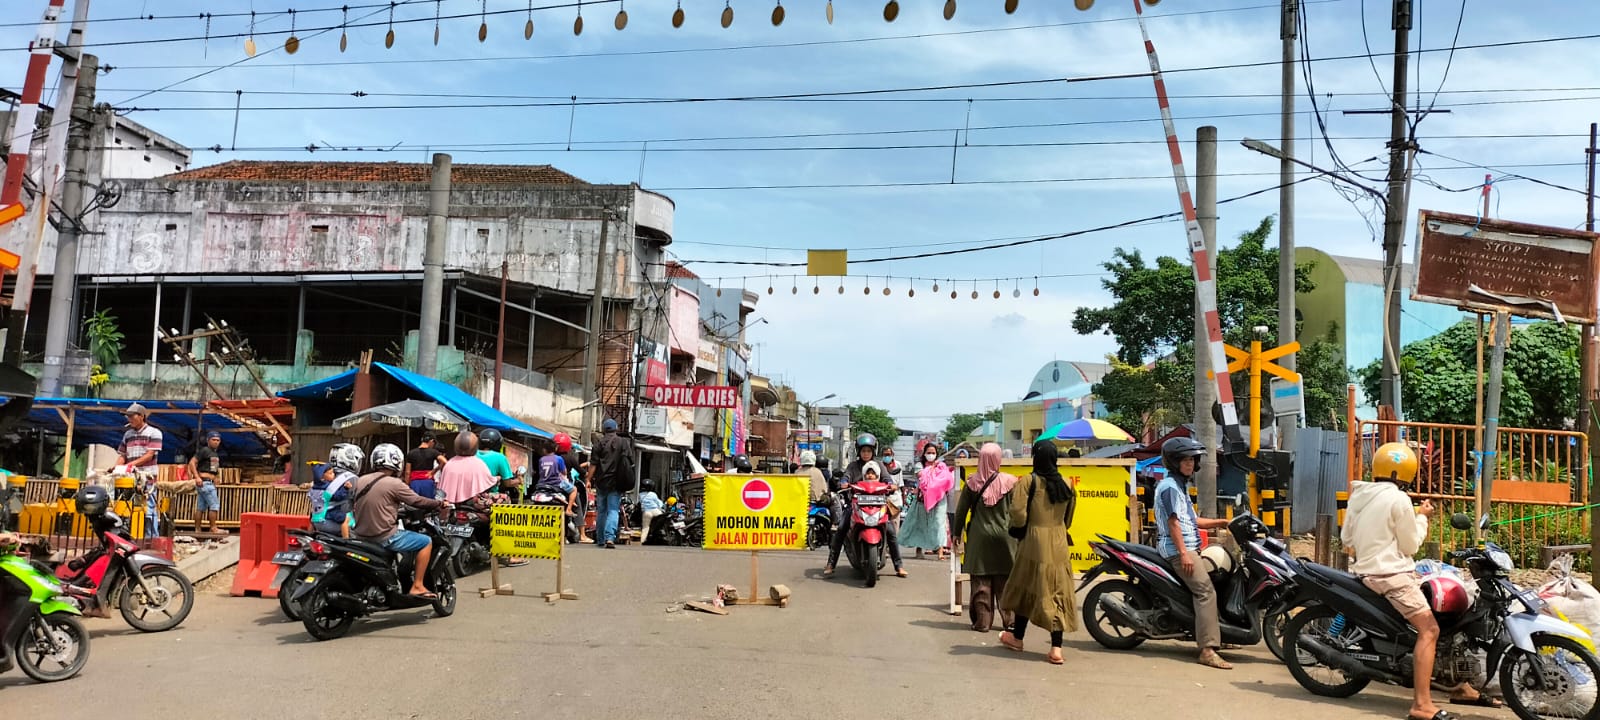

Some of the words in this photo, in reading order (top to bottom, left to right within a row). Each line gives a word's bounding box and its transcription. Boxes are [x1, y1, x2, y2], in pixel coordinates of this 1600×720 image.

[654, 386, 694, 405] OPTIK
[697, 389, 736, 406] ARIES
[542, 465, 551, 477] 7
[1079, 490, 1119, 498] TERGANGGU
[495, 512, 528, 526] MOHON
[531, 514, 556, 527] MAAF
[716, 516, 760, 529] MOHON
[763, 516, 796, 529] MAAF
[495, 529, 514, 538] SEDANG
[526, 531, 556, 540] PEKERJAAN
[713, 532, 748, 545] JALAN
[752, 532, 798, 545] DITUTUP
[513, 540, 537, 549] SALURAN
